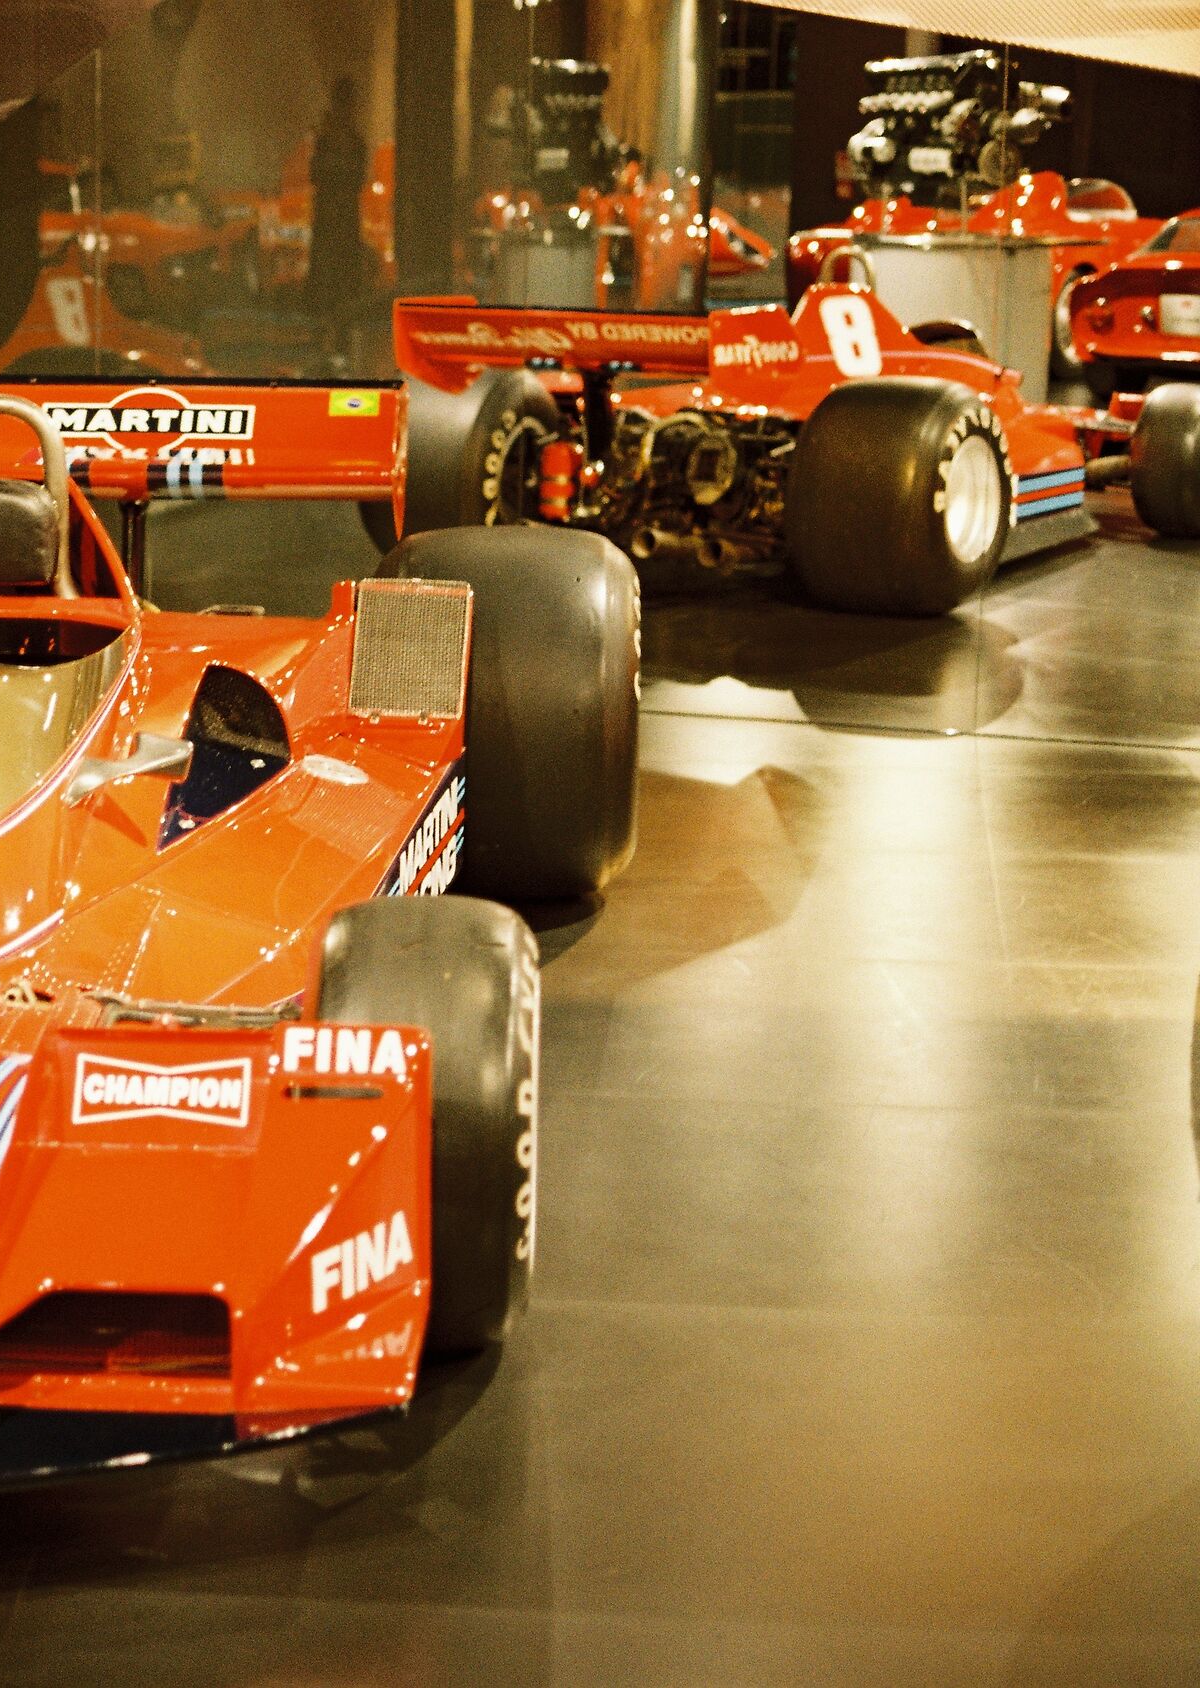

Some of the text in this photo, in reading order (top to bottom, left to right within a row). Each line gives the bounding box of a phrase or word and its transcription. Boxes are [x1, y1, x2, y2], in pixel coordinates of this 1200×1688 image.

[49, 408, 245, 435] MARTINI
[283, 1027, 408, 1075] FINA
[82, 1072, 242, 1109] CHAMPION
[311, 1211, 414, 1314] FINA
